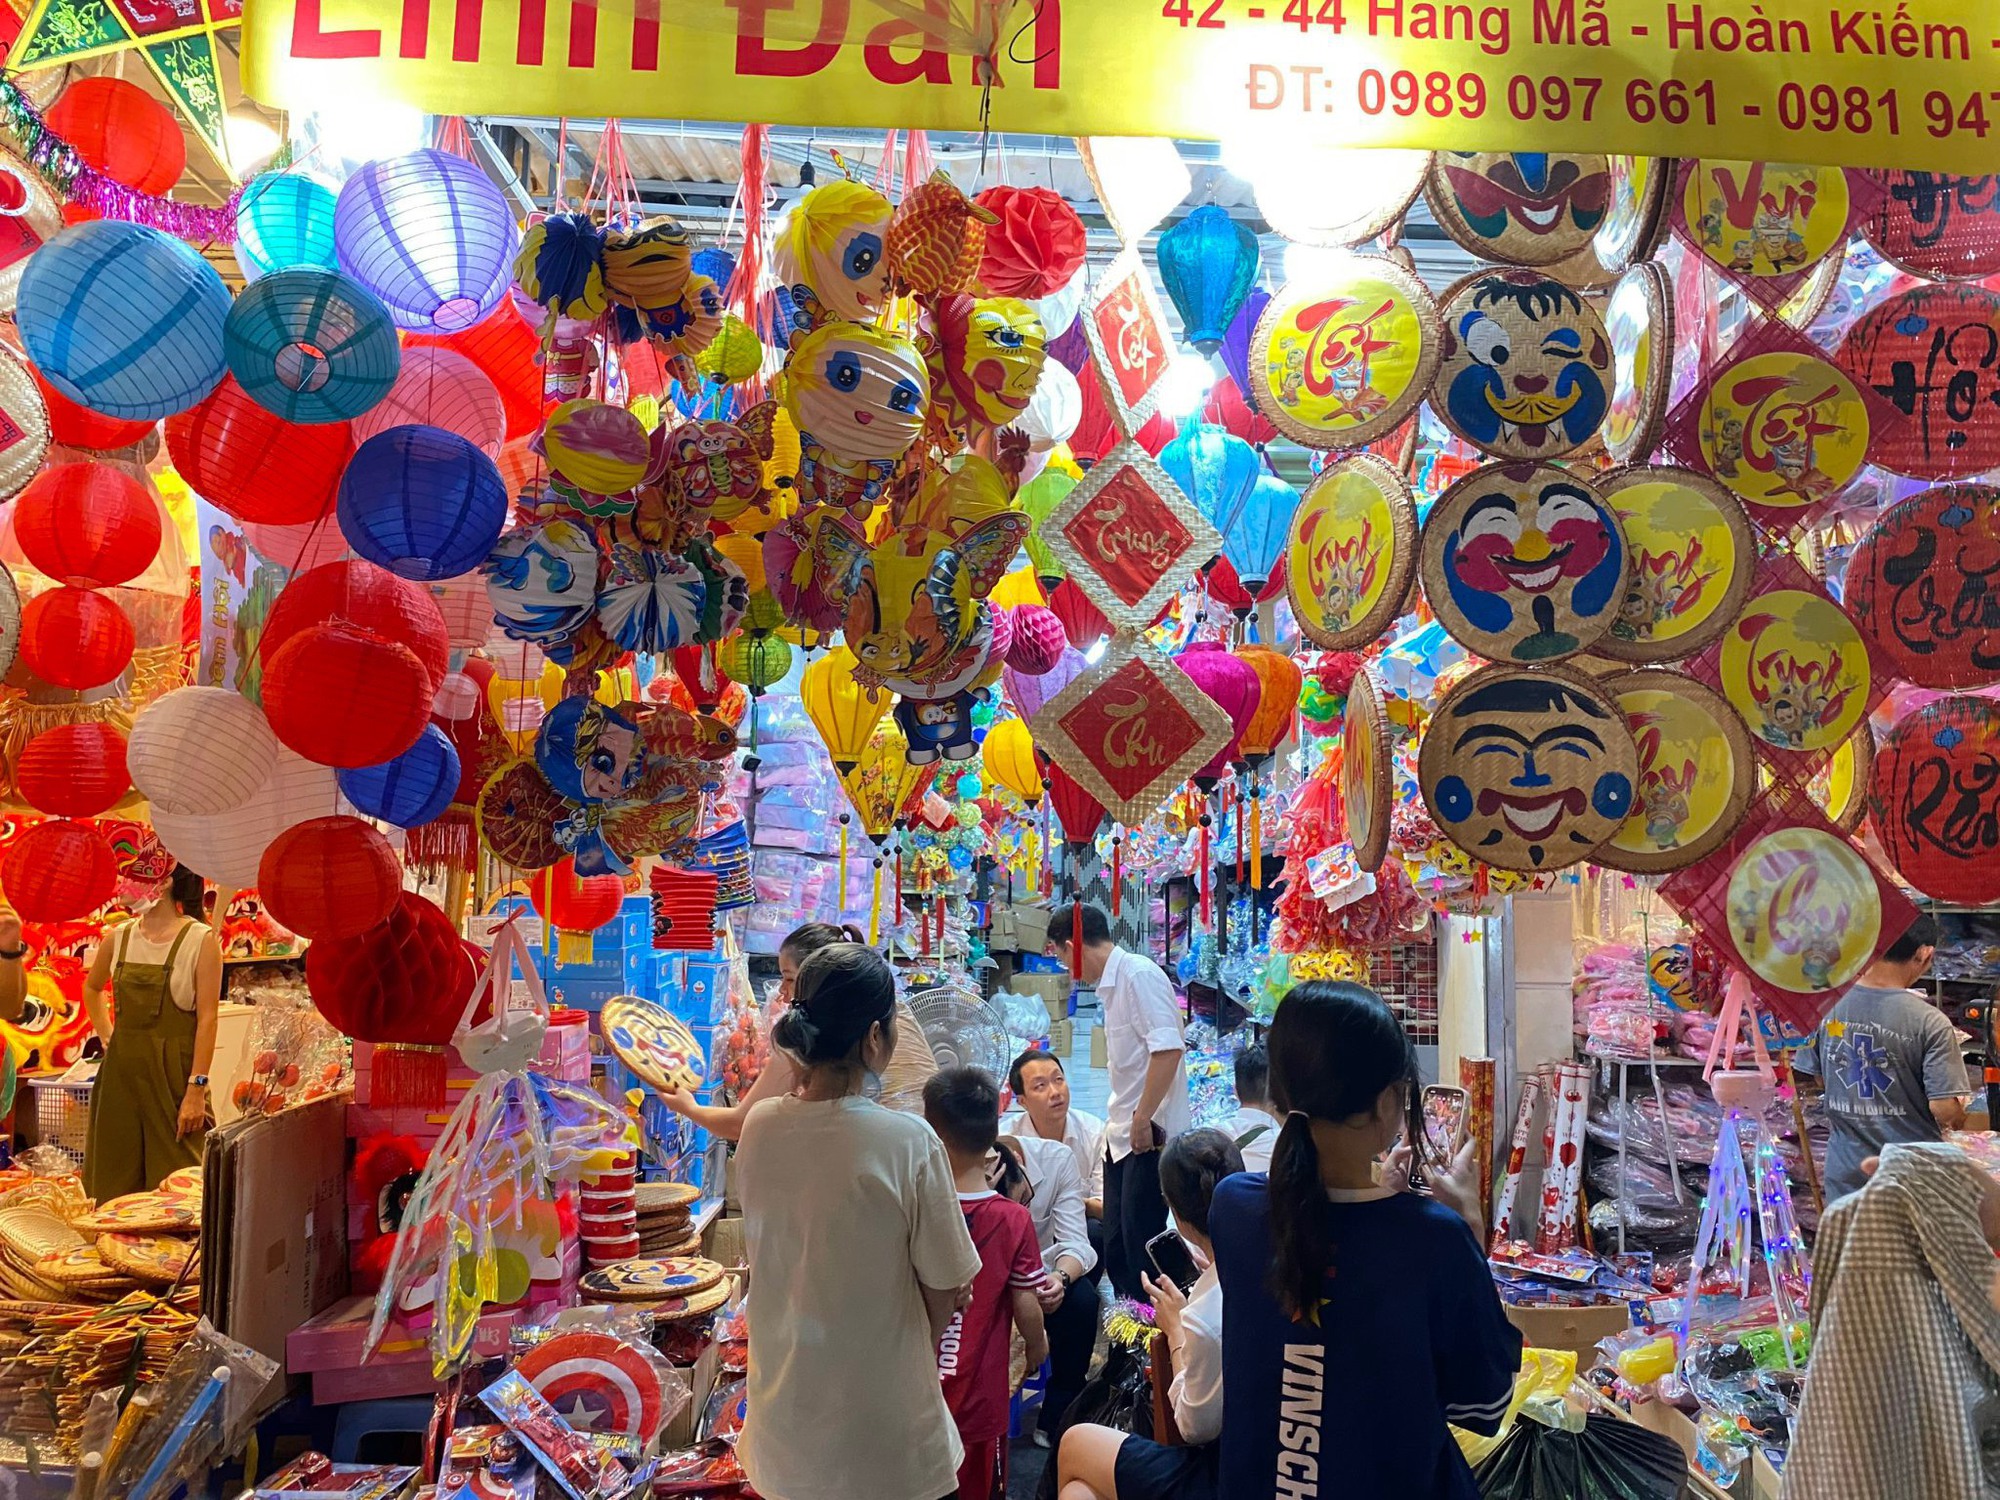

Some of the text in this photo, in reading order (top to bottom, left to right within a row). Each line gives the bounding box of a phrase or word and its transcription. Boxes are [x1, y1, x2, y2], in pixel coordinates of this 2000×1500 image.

[1282, 0, 1347, 33] 44
[1533, 0, 1612, 47] Mã
[1667, 3, 1811, 52] Hoàn
[1830, 2, 1971, 61] Kiếm
[1245, 63, 1334, 114] ĐT:
[1357, 68, 1488, 119] 0989
[1507, 74, 1603, 122] 097
[1625, 79, 1717, 126] 661
[1778, 82, 1901, 136] 0981
[1923, 90, 2000, 139] 94
[1296, 298, 1401, 398] Tết
[1731, 375, 1849, 473] Tết
[1093, 495, 1172, 571] Trung
[1103, 687, 1168, 769] Thu
